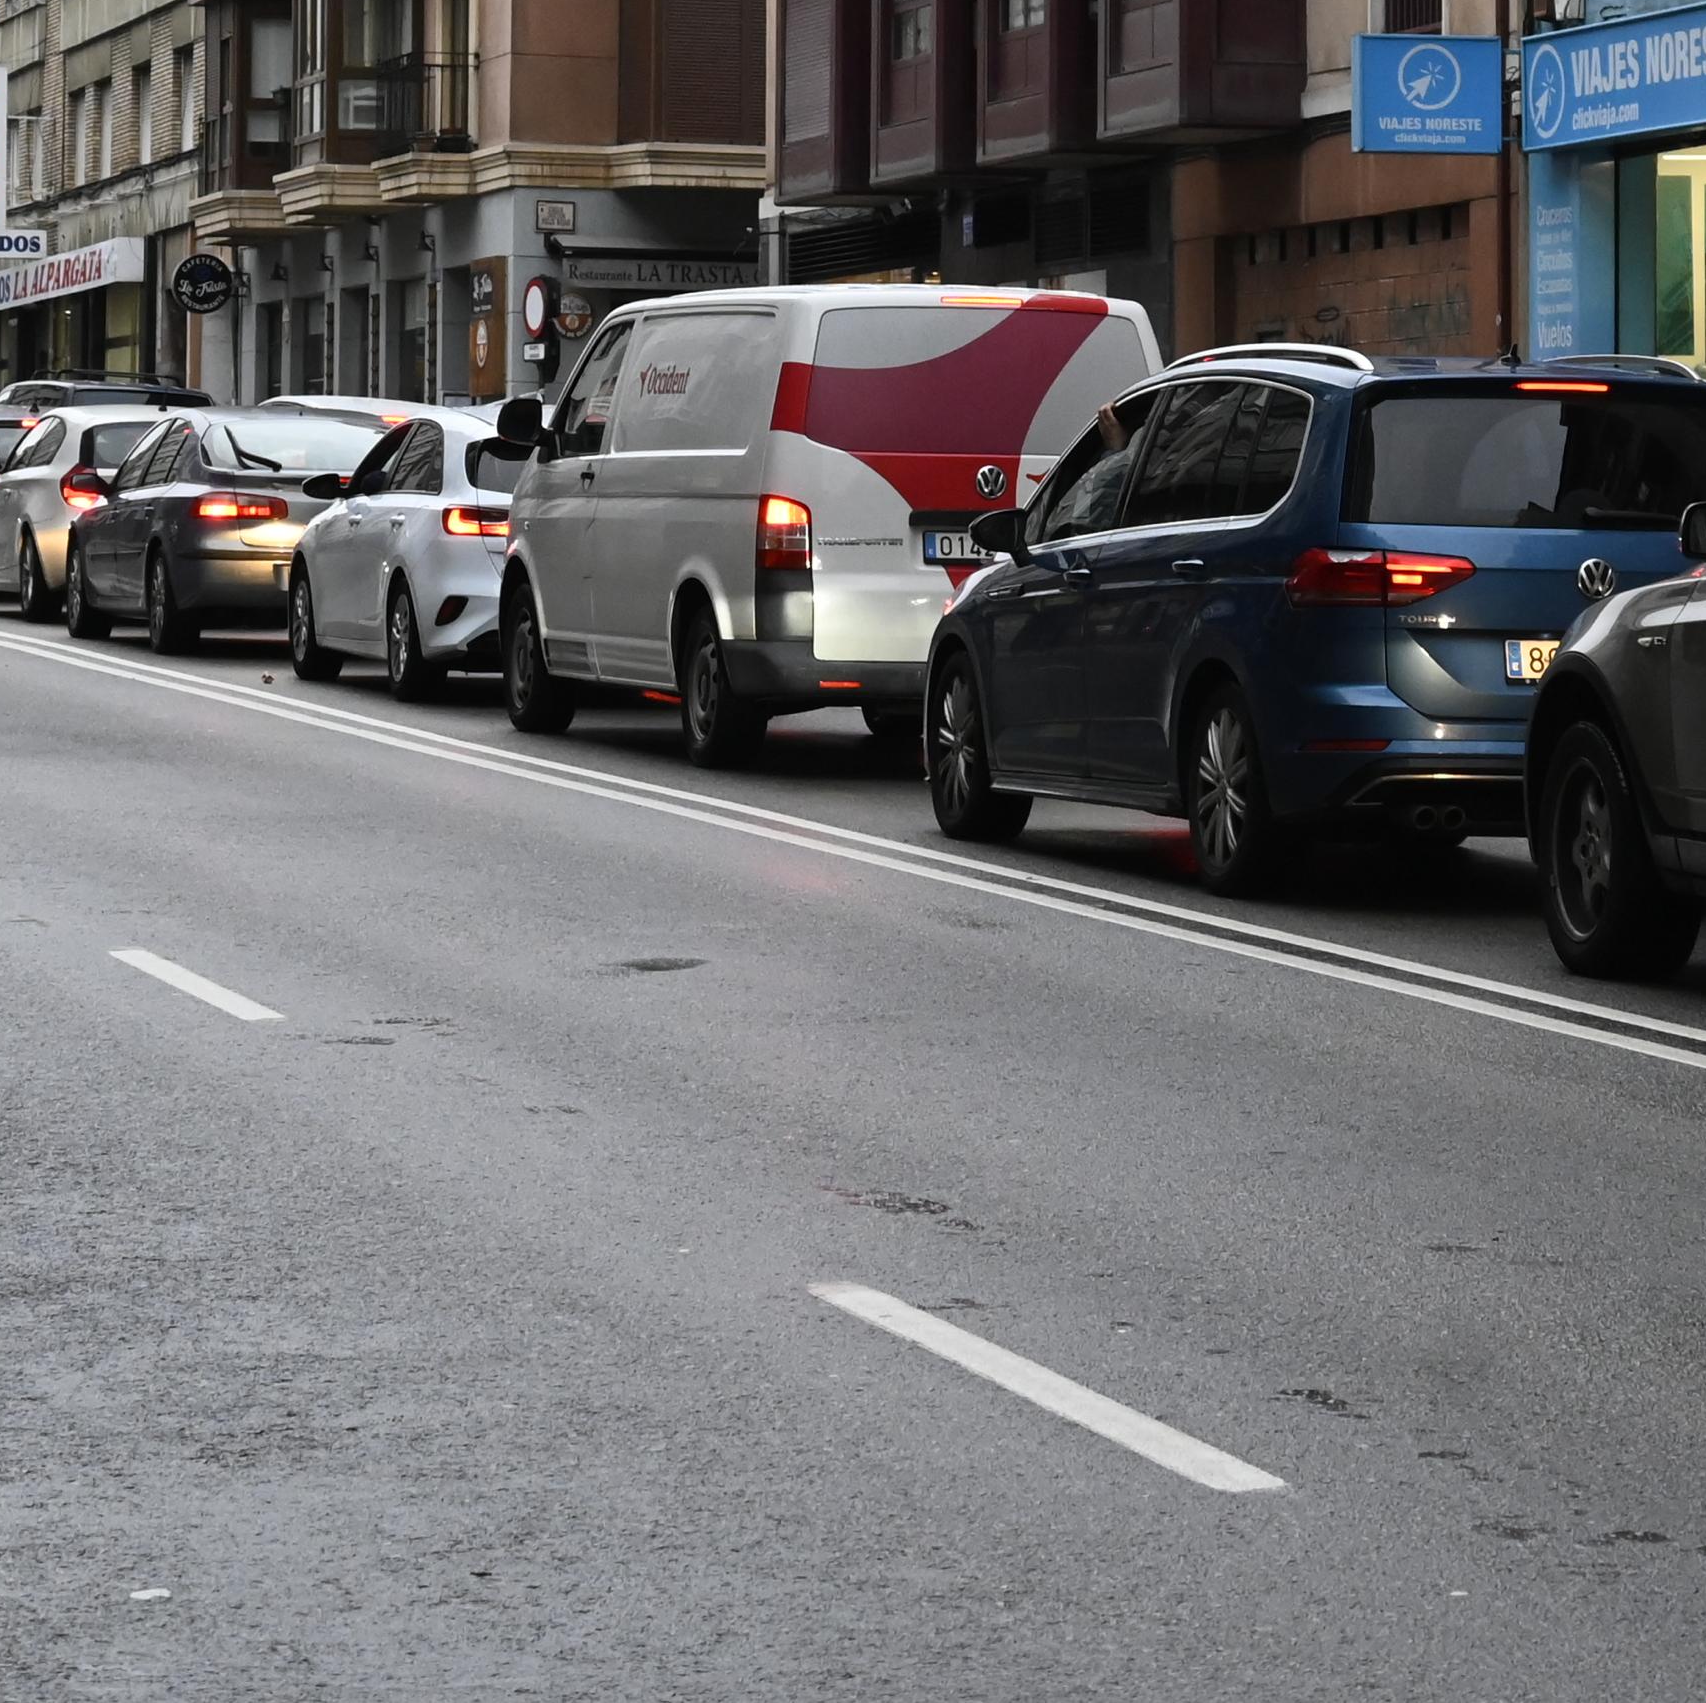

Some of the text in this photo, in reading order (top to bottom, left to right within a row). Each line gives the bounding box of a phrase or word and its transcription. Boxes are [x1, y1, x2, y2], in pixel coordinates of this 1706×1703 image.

[1570, 39, 1640, 97] VIAJES
[1379, 117, 1482, 131] VIAJES NORESTE
[1572, 102, 1640, 130] clickviaja.com
[1395, 133, 1466, 145] clickviaja.com
[1537, 205, 1573, 226] Cruceros
[12, 269, 28, 300] LA
[30, 249, 102, 296] ALPARGATA
[568, 265, 633, 282] Restaurante
[637, 263, 661, 282] LA
[1537, 321, 1573, 349] Vuelos
[647, 365, 691, 395] Occident
